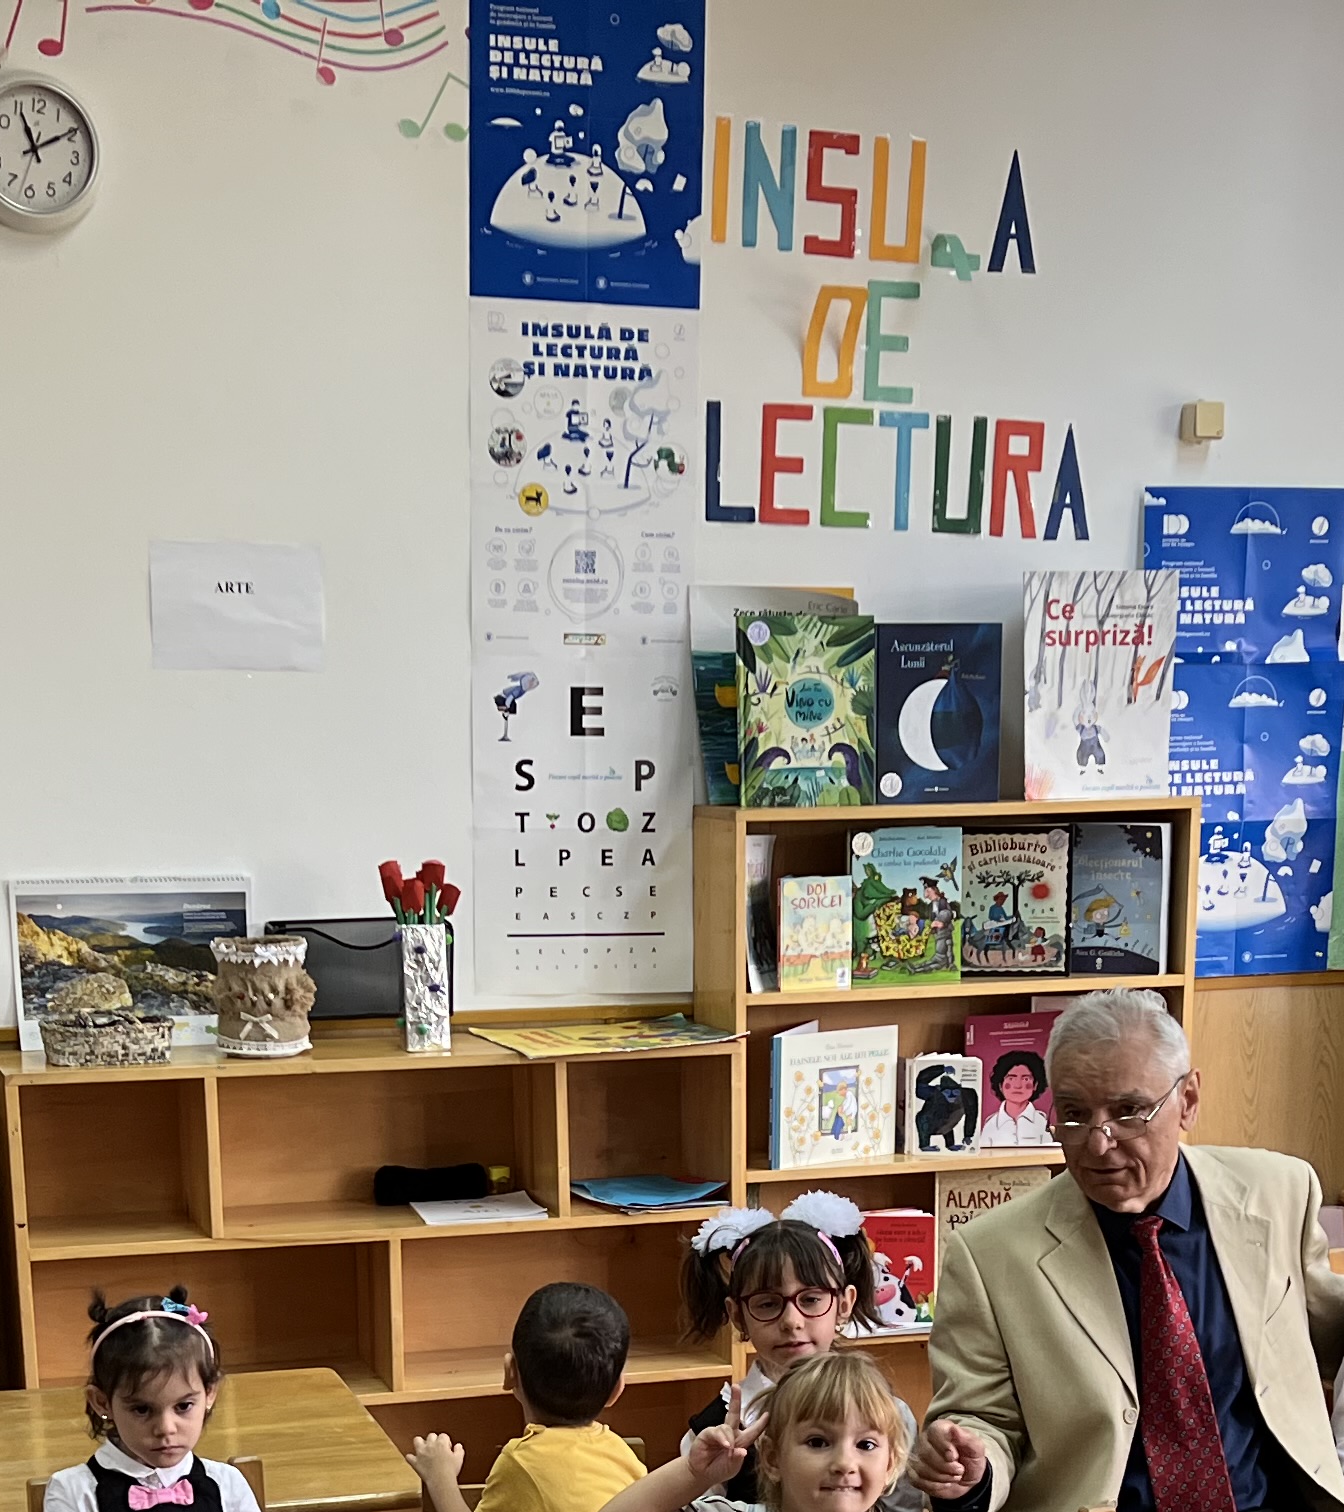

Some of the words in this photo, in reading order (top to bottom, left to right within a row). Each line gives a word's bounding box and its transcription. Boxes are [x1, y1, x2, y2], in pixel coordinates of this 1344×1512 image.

[489, 33, 559, 52] INSULE
[489, 50, 514, 65] DE
[519, 51, 603, 71] LECTURĂ
[513, 67, 593, 86] NATURĂ
[31, 98, 47, 115] 12
[56, 108, 60, 123] 1
[70, 151, 79, 166] 3
[8, 173, 18, 187] 7
[62, 171, 72, 186] 4
[24, 184, 35, 198] 6
[46, 182, 56, 197] 5
[521, 322, 612, 341] INSULĂ
[620, 327, 649, 342] DE
[532, 342, 639, 361] LECTURĂ
[802, 280, 920, 404] DE
[553, 362, 653, 381] NATURĂ
[705, 400, 1090, 541] LECTURA
[214, 581, 255, 594] ARTE
[1180, 586, 1220, 598] SULE
[1046, 599, 1075, 620] Ce
[1045, 623, 1153, 653] surpriză!
[570, 686, 605, 737] E
[515, 759, 535, 791] S
[635, 760, 656, 792] P
[515, 812, 530, 833] T
[641, 812, 656, 833] Z
[968, 838, 1048, 856] Biblioburro
[515, 849, 526, 866] L
[559, 849, 571, 866] P
[601, 849, 613, 866] E
[641, 849, 656, 866] A
[806, 882, 827, 896] DOI
[945, 1186, 1013, 1210] ALARMĂ
